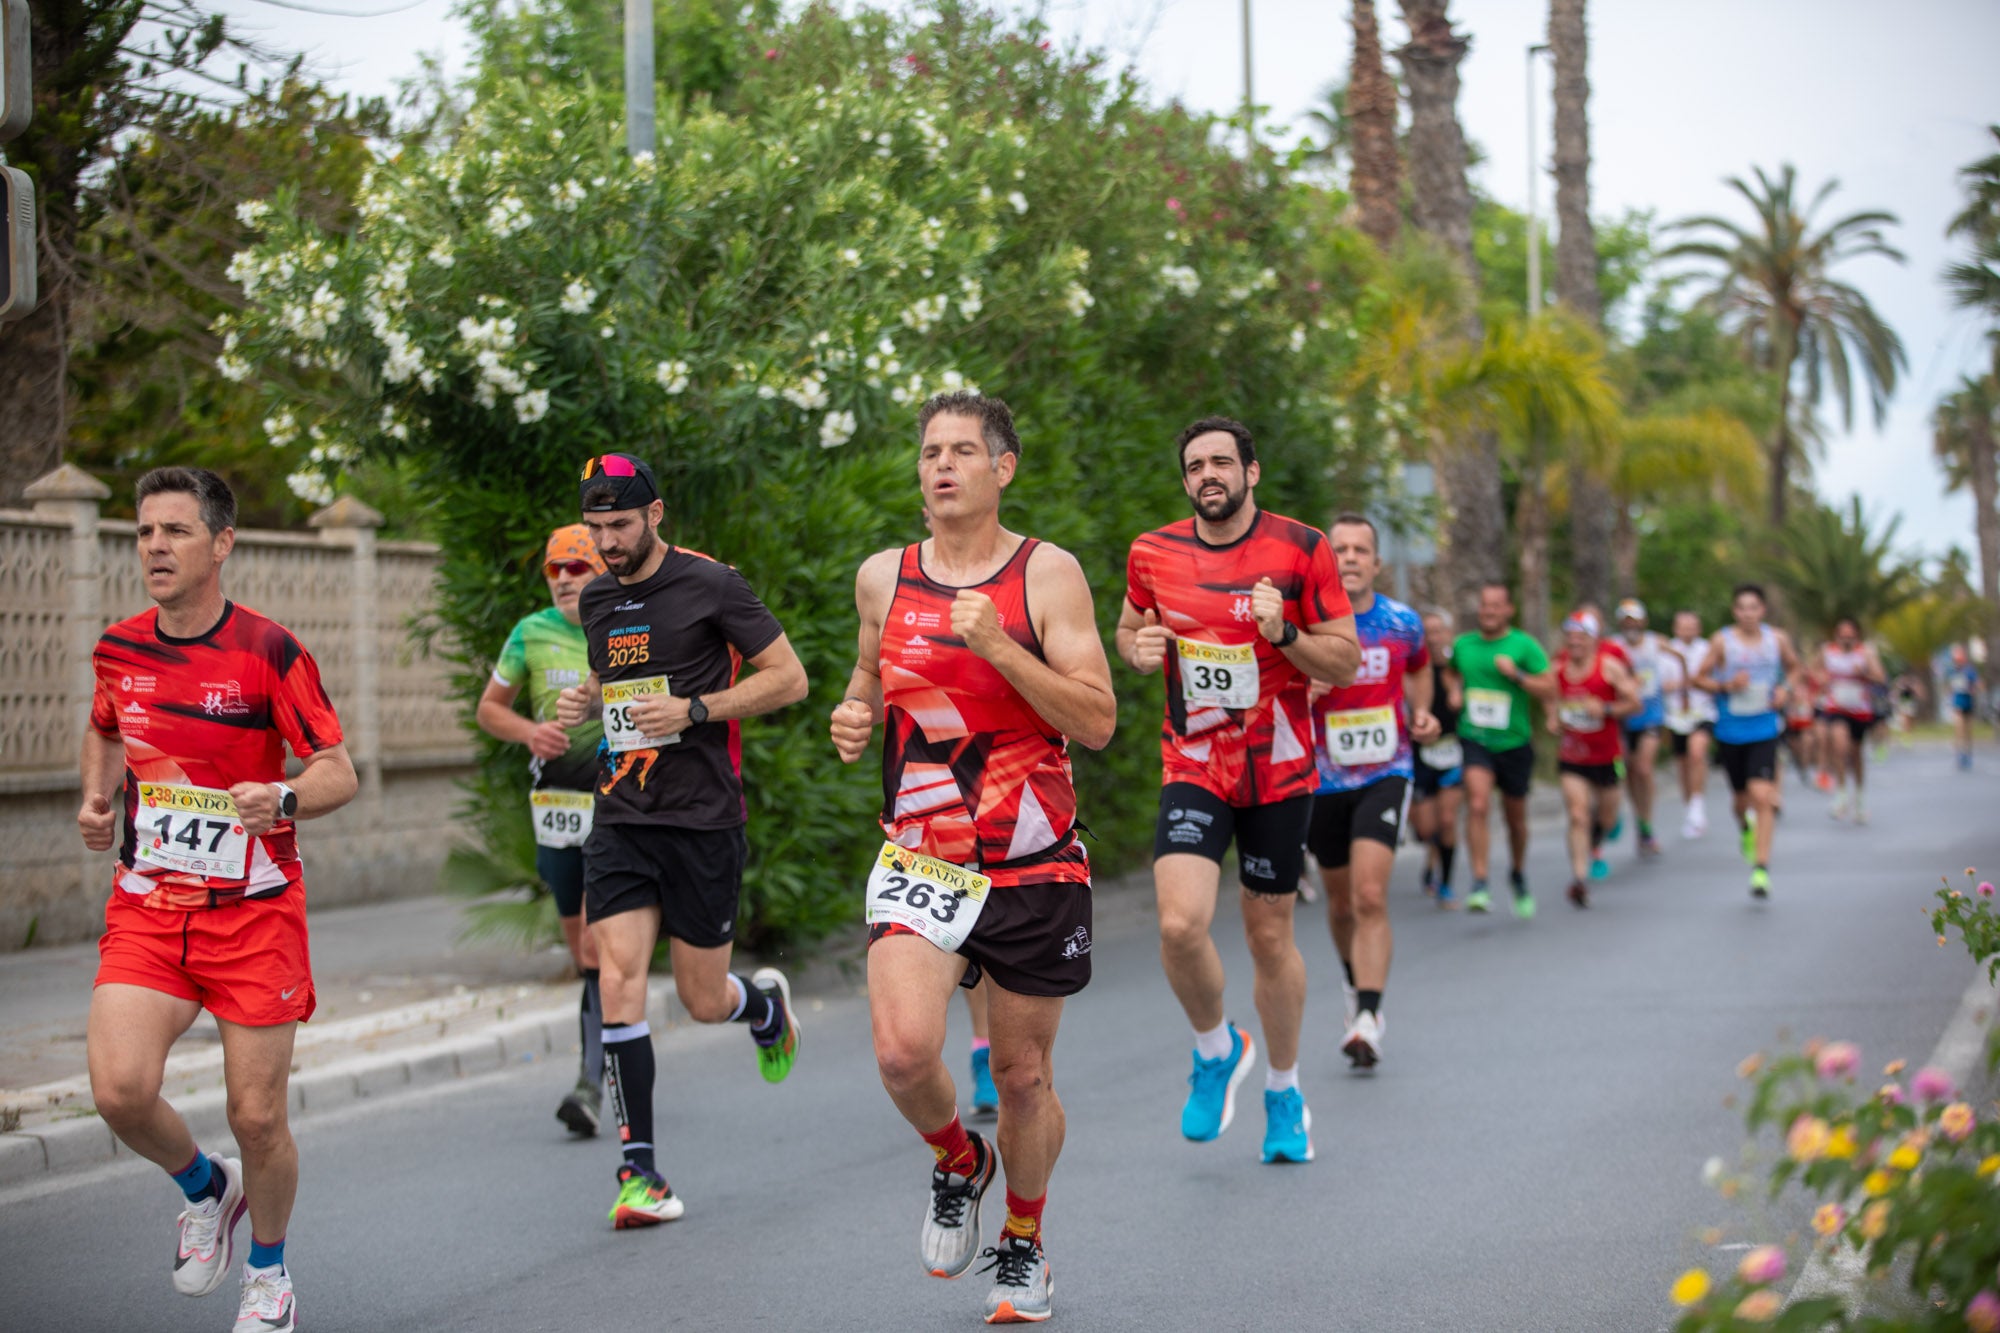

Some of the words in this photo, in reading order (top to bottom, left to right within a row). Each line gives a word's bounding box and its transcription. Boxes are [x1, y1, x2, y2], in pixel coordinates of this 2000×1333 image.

[608, 633, 650, 650] FONDO
[609, 629, 624, 637] GRAN
[626, 625, 651, 635] PREMIO
[608, 645, 650, 668] 2025
[1194, 666, 1232, 690] 39
[609, 706, 637, 733] 39
[1339, 727, 1387, 751] 970
[155, 787, 172, 803] 38
[172, 793, 228, 811] FONDO
[175, 788, 195, 796] GRAN
[542, 809, 581, 833] 499
[153, 814, 231, 854] 147
[898, 851, 914, 868] 38
[912, 861, 965, 888] FONDO
[877, 876, 960, 923] 263
